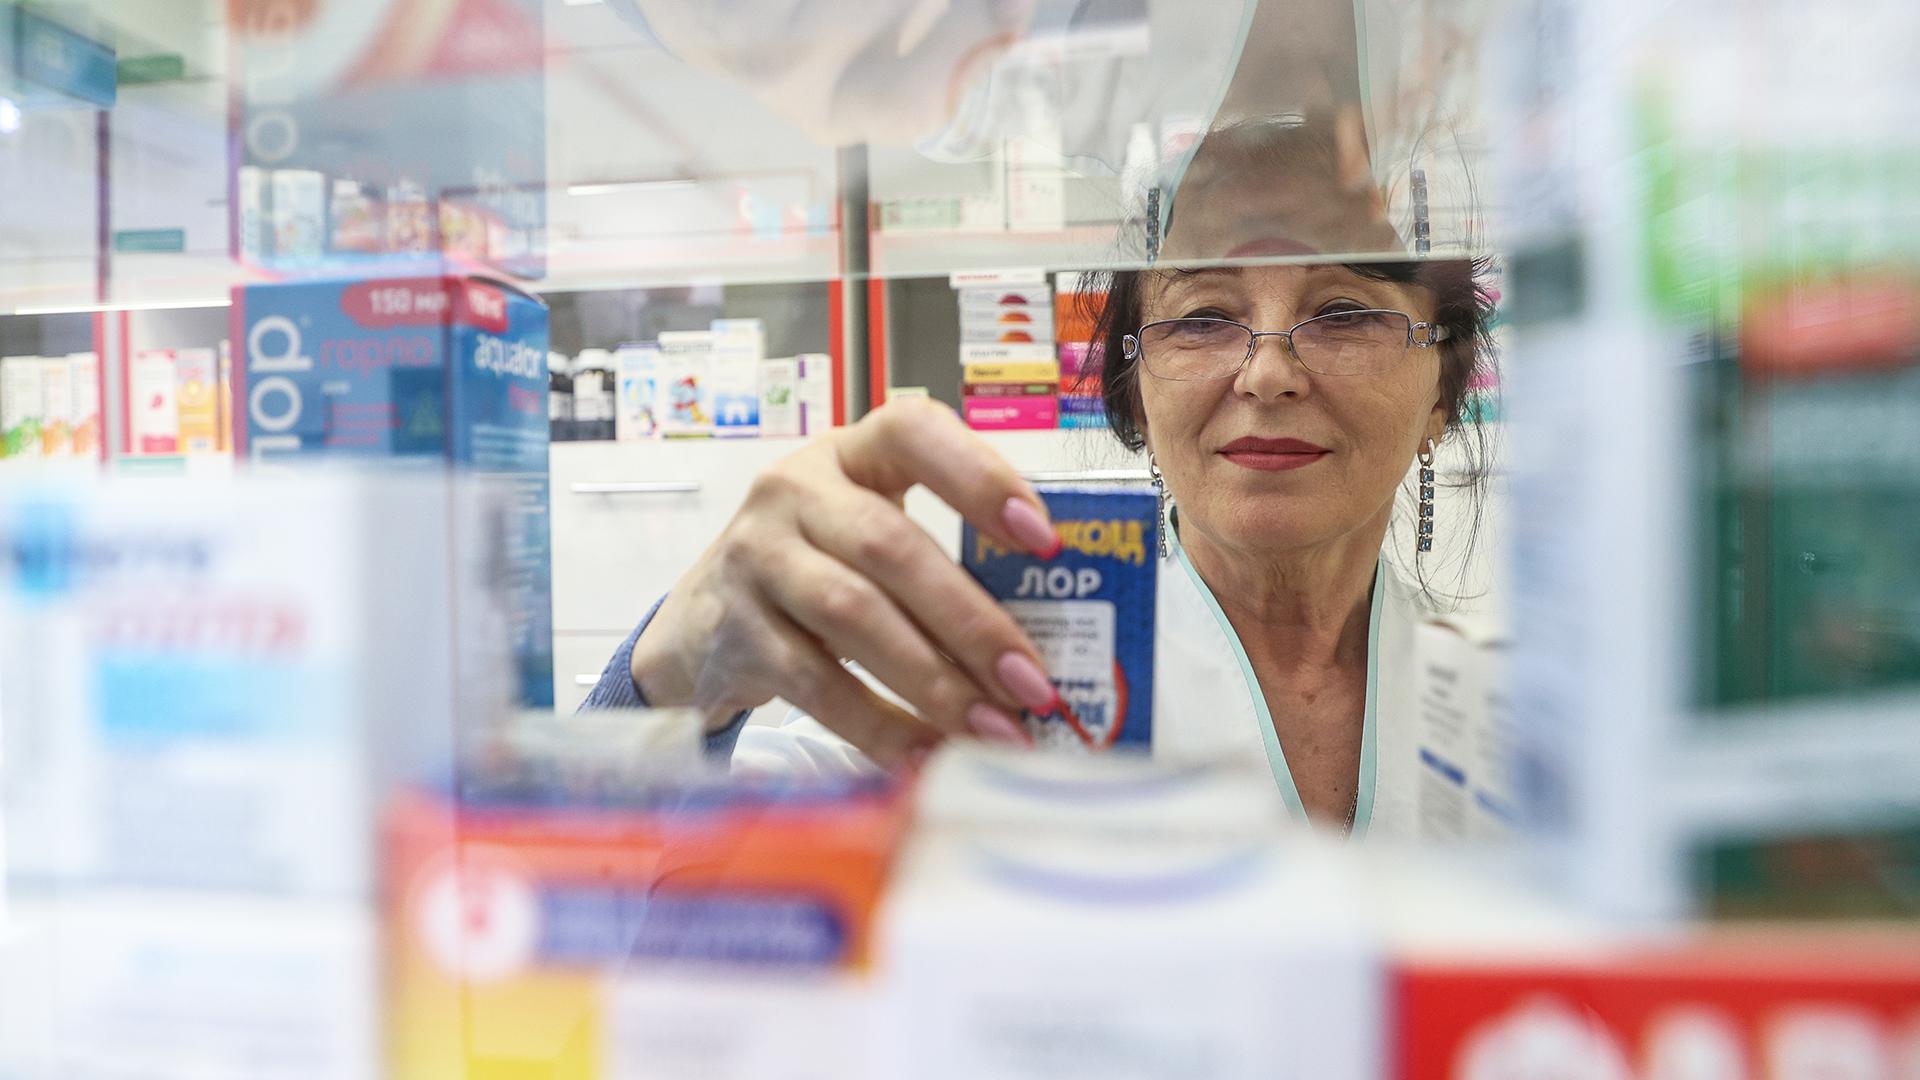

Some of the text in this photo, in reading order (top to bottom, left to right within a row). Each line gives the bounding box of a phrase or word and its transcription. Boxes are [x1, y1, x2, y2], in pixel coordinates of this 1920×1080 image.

[370, 287, 412, 315] 150
[320, 335, 434, 379] горло
[1015, 565, 1103, 600] ЛОР
